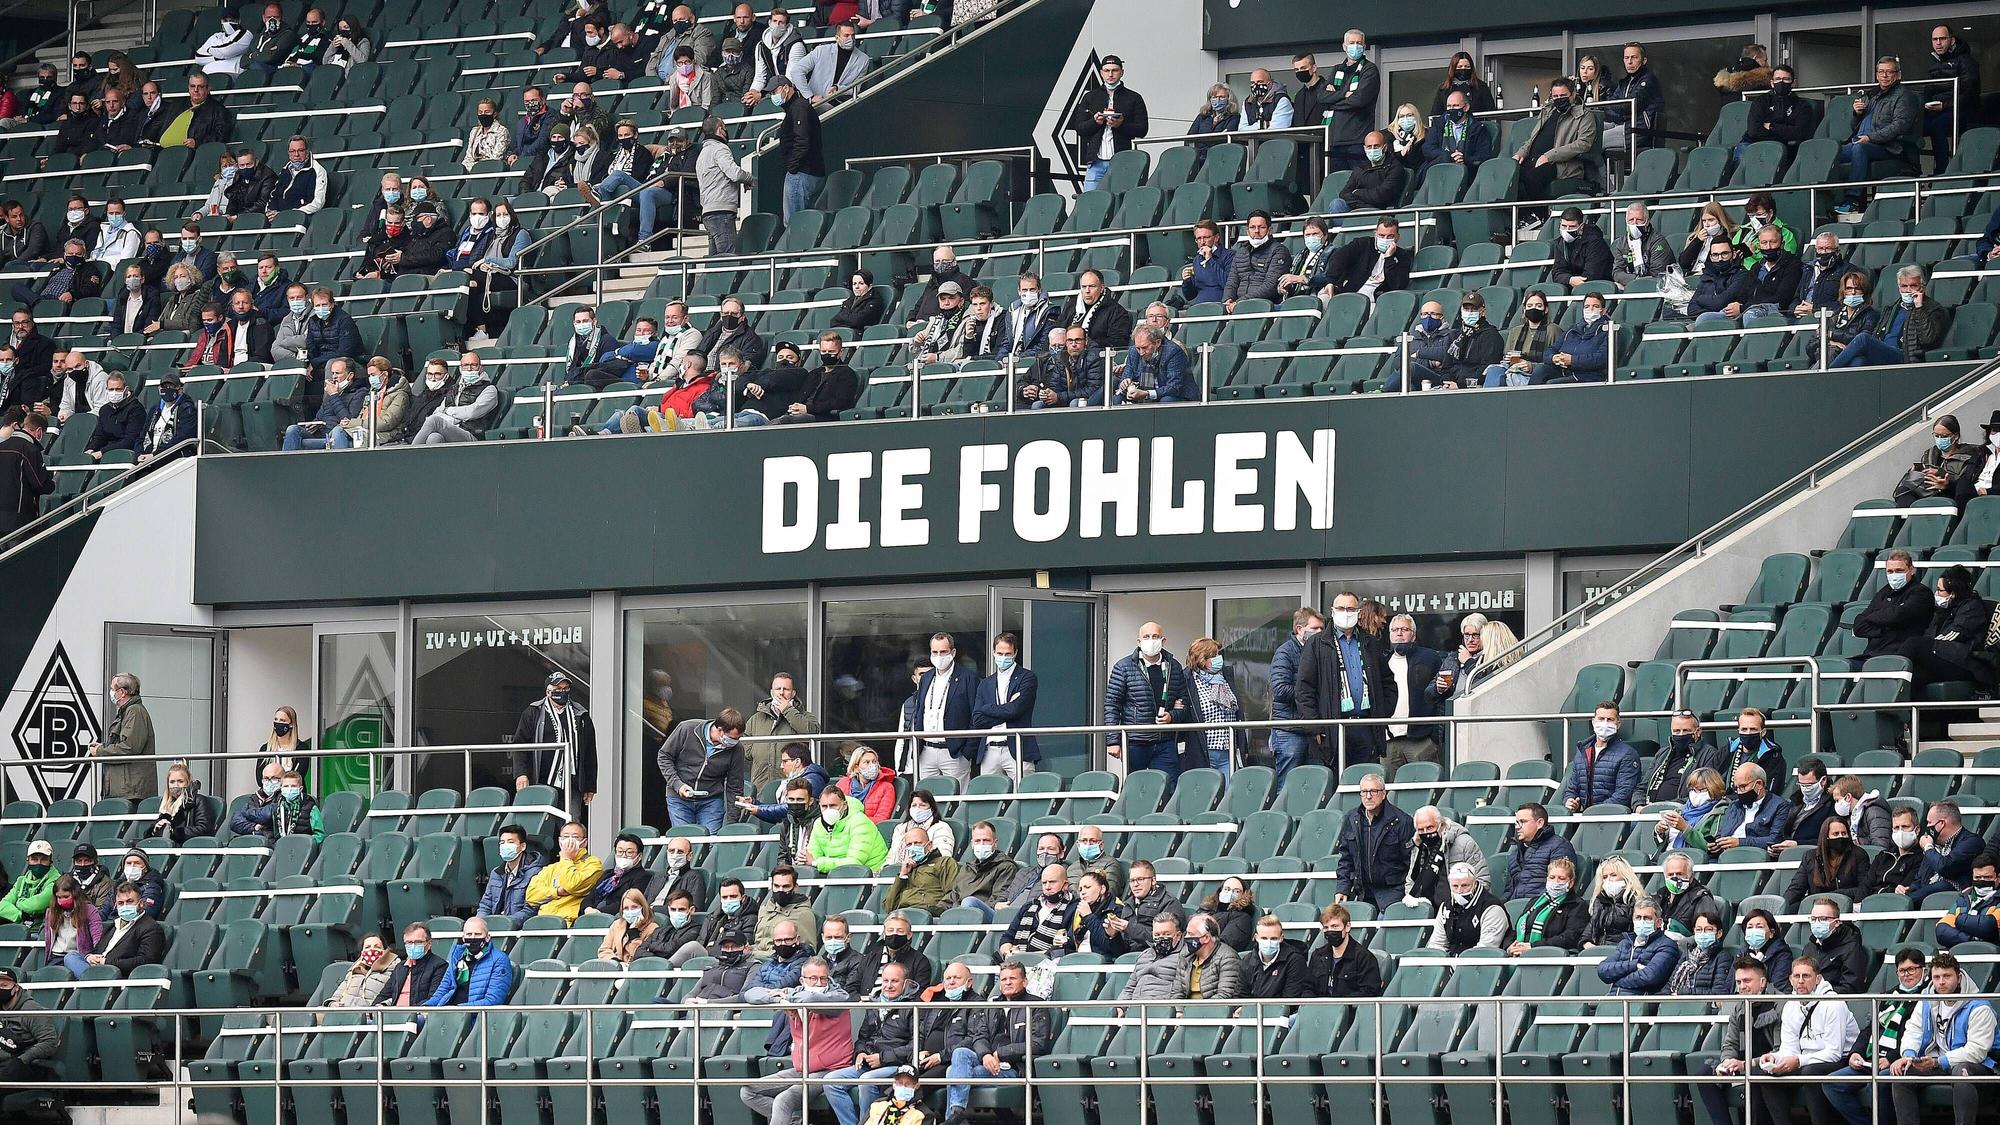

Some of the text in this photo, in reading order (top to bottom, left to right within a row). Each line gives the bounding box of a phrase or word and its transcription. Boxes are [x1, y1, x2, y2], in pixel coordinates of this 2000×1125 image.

[761, 428, 1336, 554] DIE FOHLEN
[40, 703, 79, 769] B
